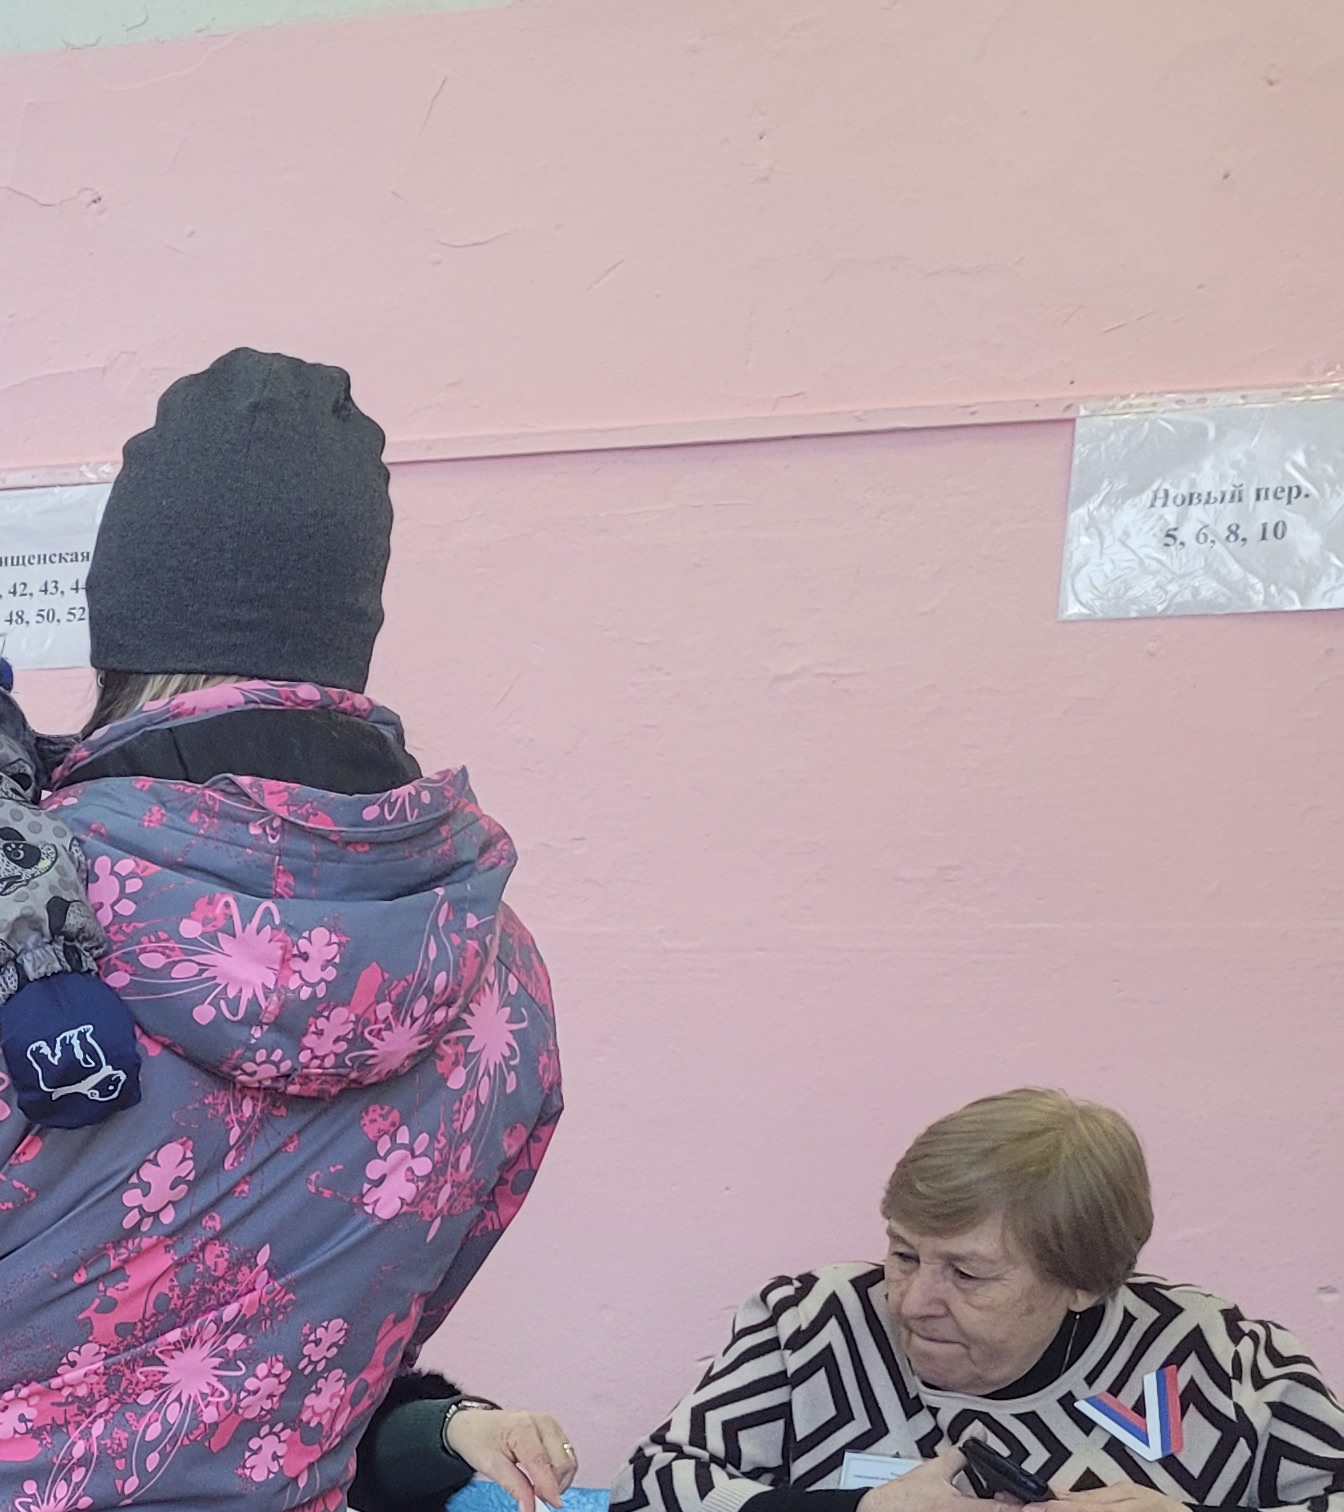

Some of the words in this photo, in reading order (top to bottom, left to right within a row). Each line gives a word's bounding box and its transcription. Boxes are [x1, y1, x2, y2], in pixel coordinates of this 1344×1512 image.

[1148, 482, 1244, 508] Новый
[1254, 483, 1310, 506] пер.
[1162, 526, 1186, 551] 5,
[1194, 524, 1217, 549] 6,
[1224, 522, 1249, 547] 8,
[1257, 519, 1288, 542] 10
[7, 581, 34, 600] 42,
[38, 579, 65, 598] 43,
[3, 609, 31, 628] 48,
[35, 607, 62, 627] 50,
[65, 606, 87, 623] 52
